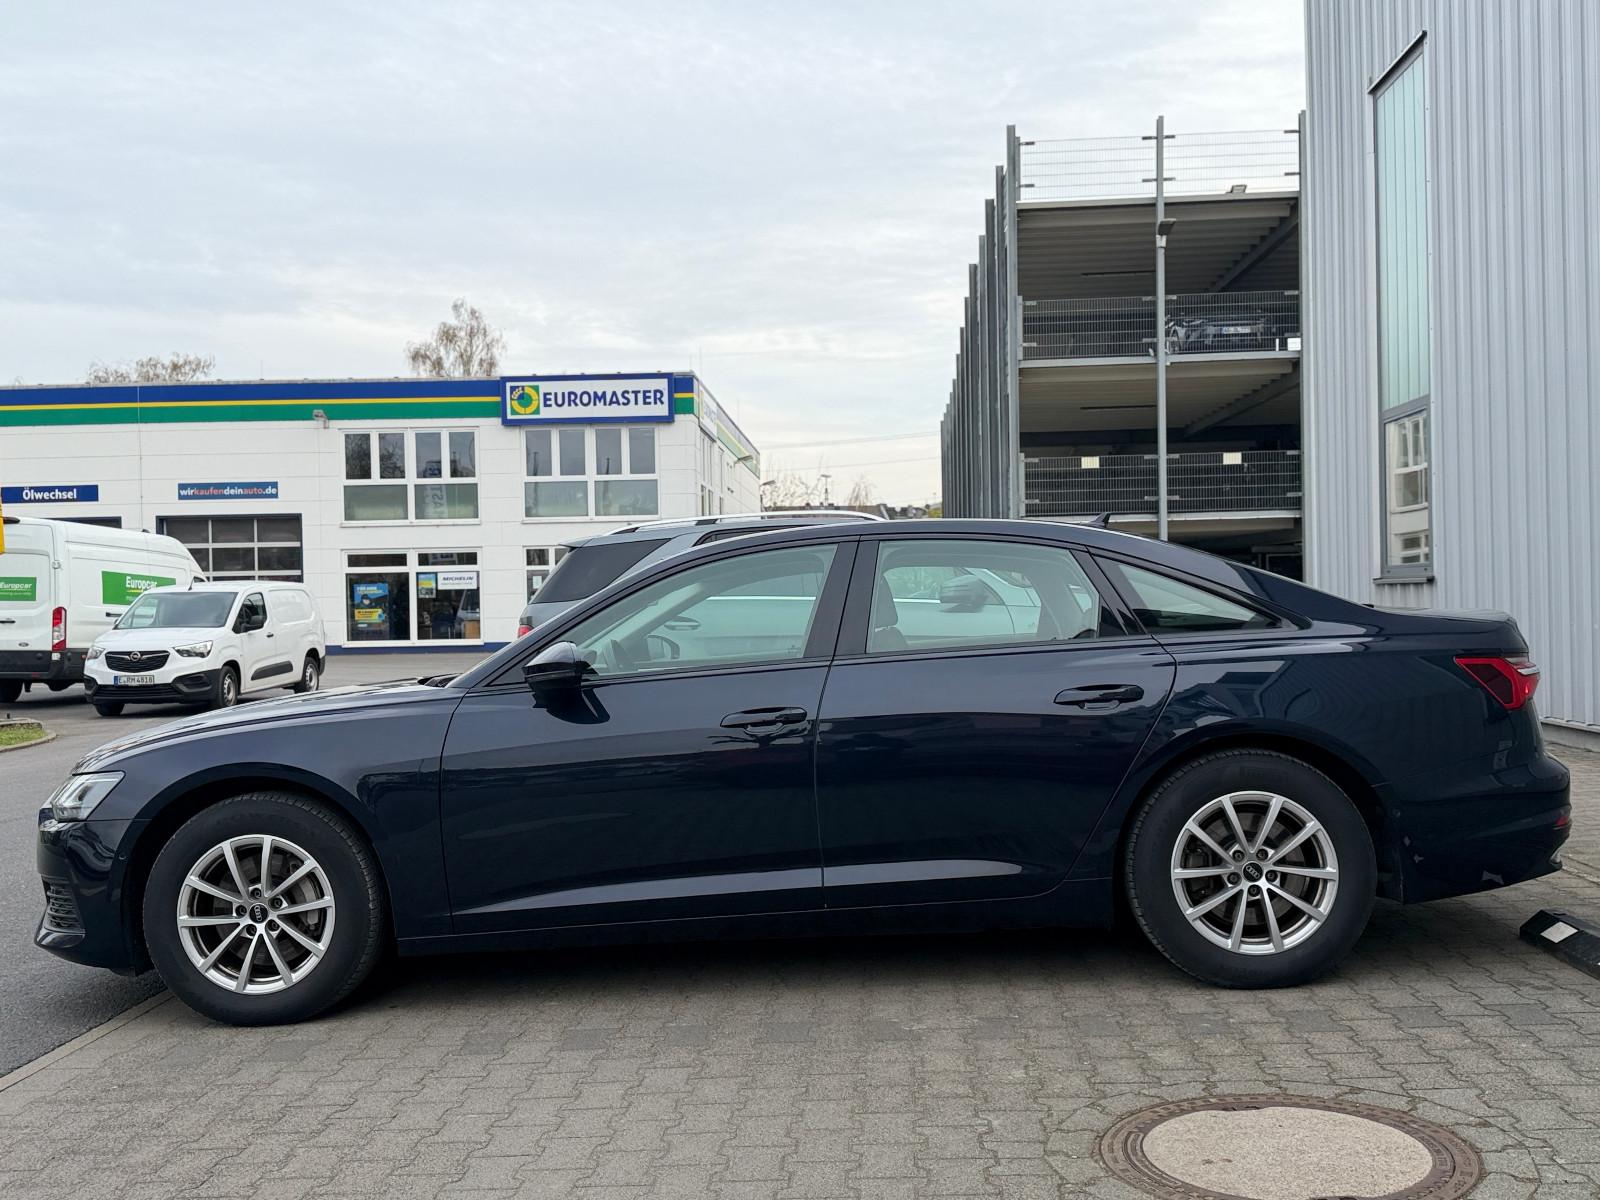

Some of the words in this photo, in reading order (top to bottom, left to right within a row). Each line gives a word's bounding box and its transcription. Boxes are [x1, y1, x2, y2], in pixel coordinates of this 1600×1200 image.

[543, 389, 665, 408] EUROMASTER
[22, 486, 77, 501] Ölwechsel
[179, 486, 278, 496] wirkaufendeinauto.de
